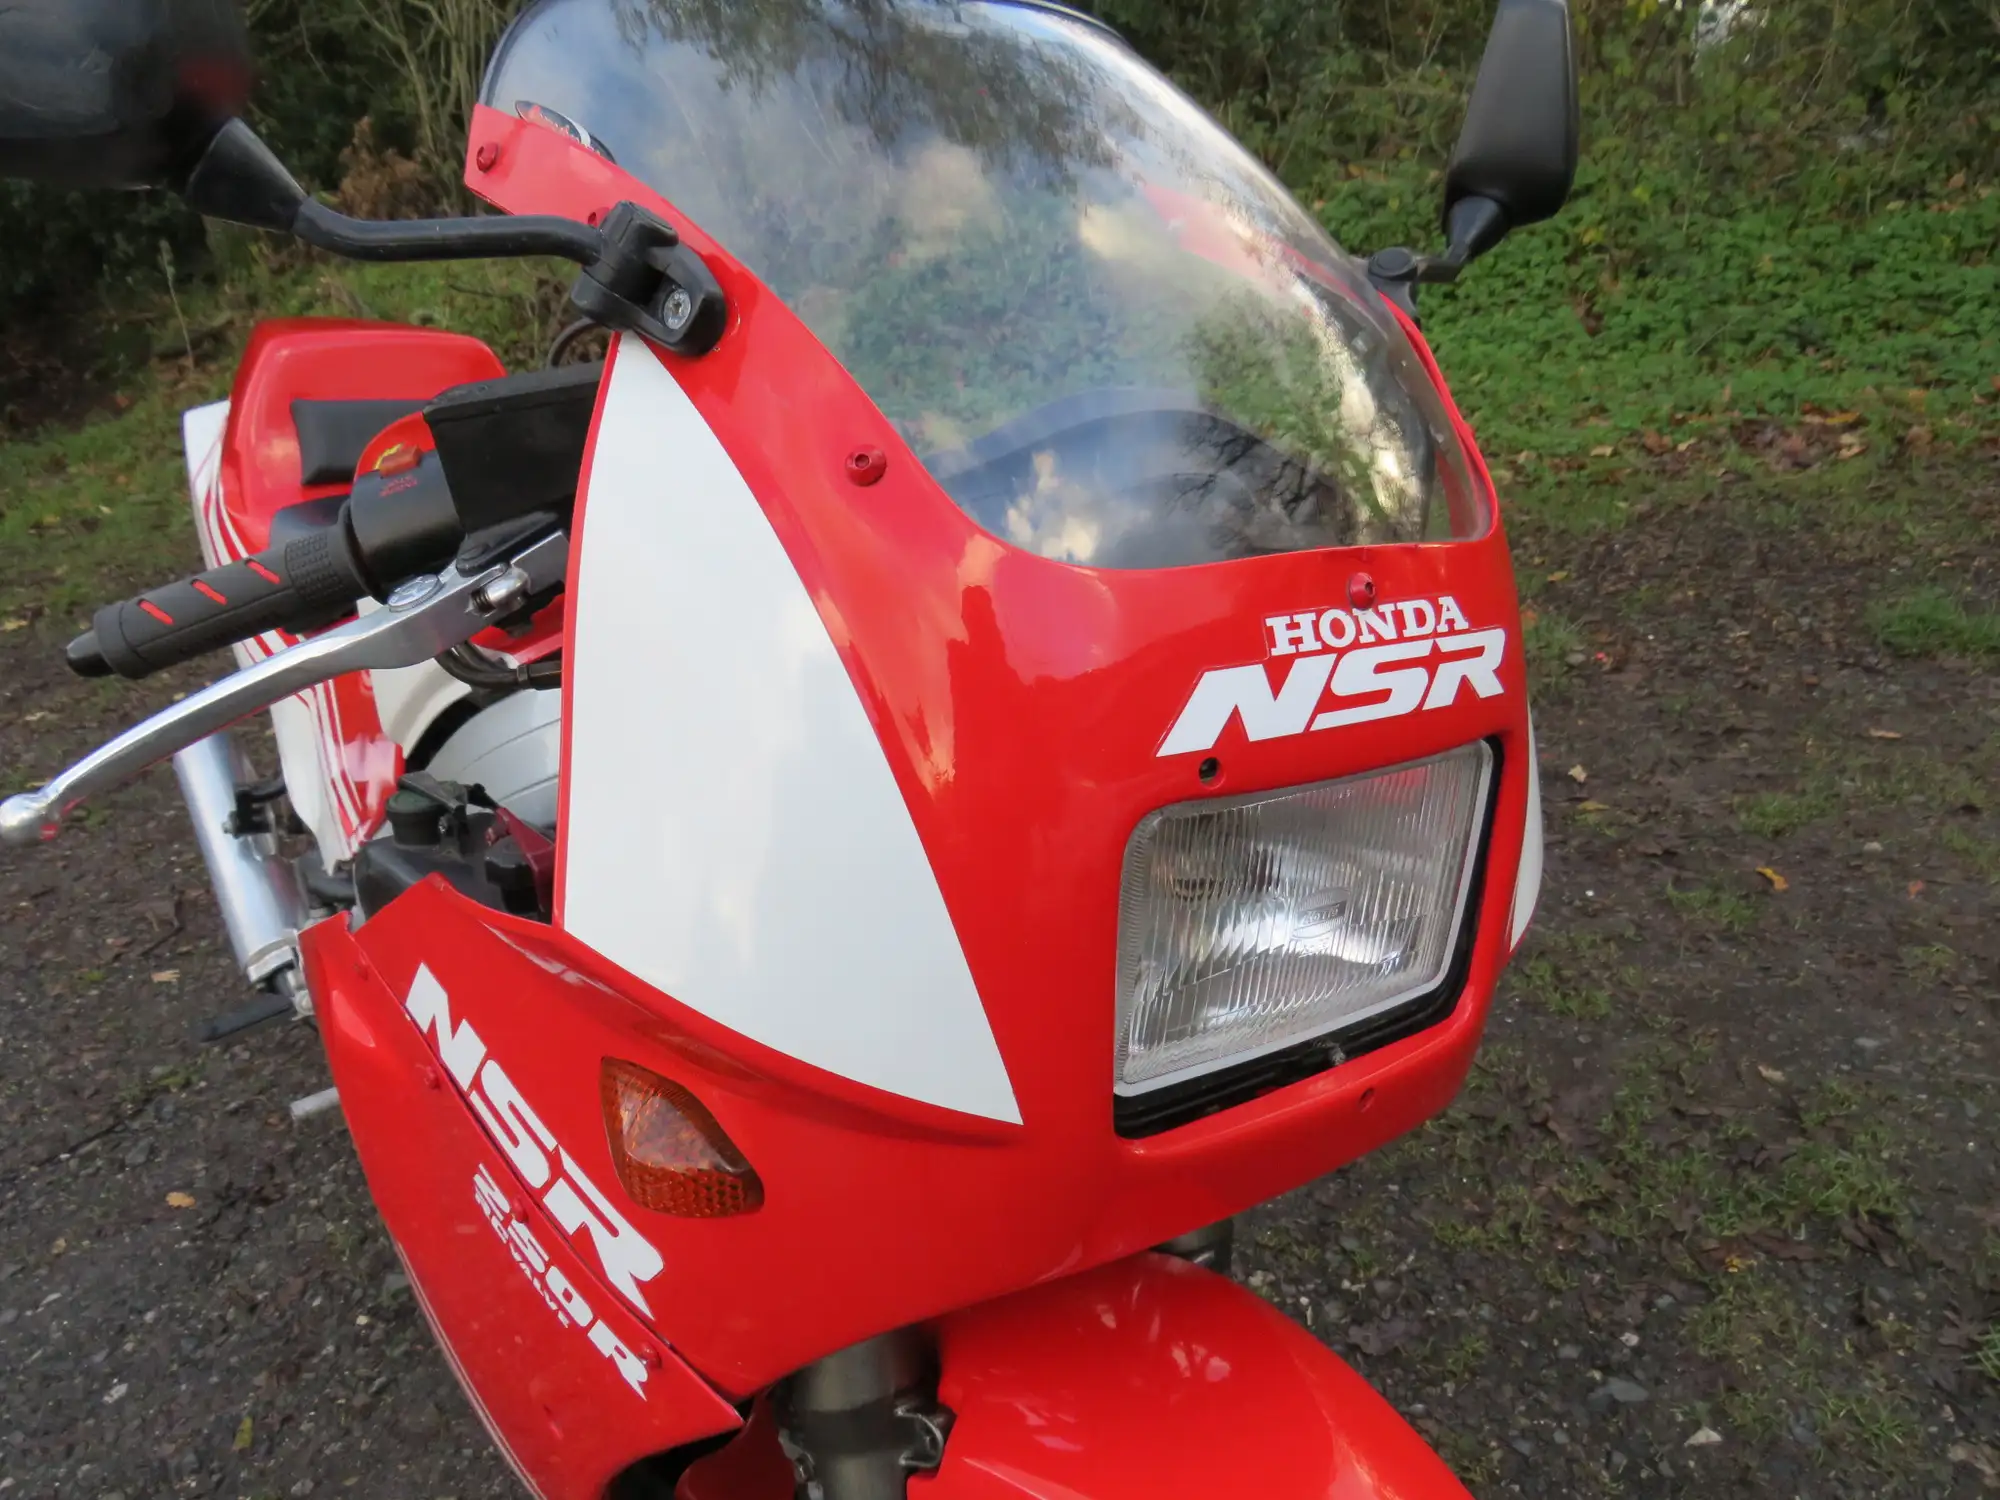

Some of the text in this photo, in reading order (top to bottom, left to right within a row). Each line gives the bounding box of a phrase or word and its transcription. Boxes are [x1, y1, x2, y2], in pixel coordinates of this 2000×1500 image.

[1155, 628, 1506, 757] NSR
[1265, 597, 1469, 656] HONDA
[406, 961, 664, 1321] NSR
[473, 1164, 648, 1401] 250R
